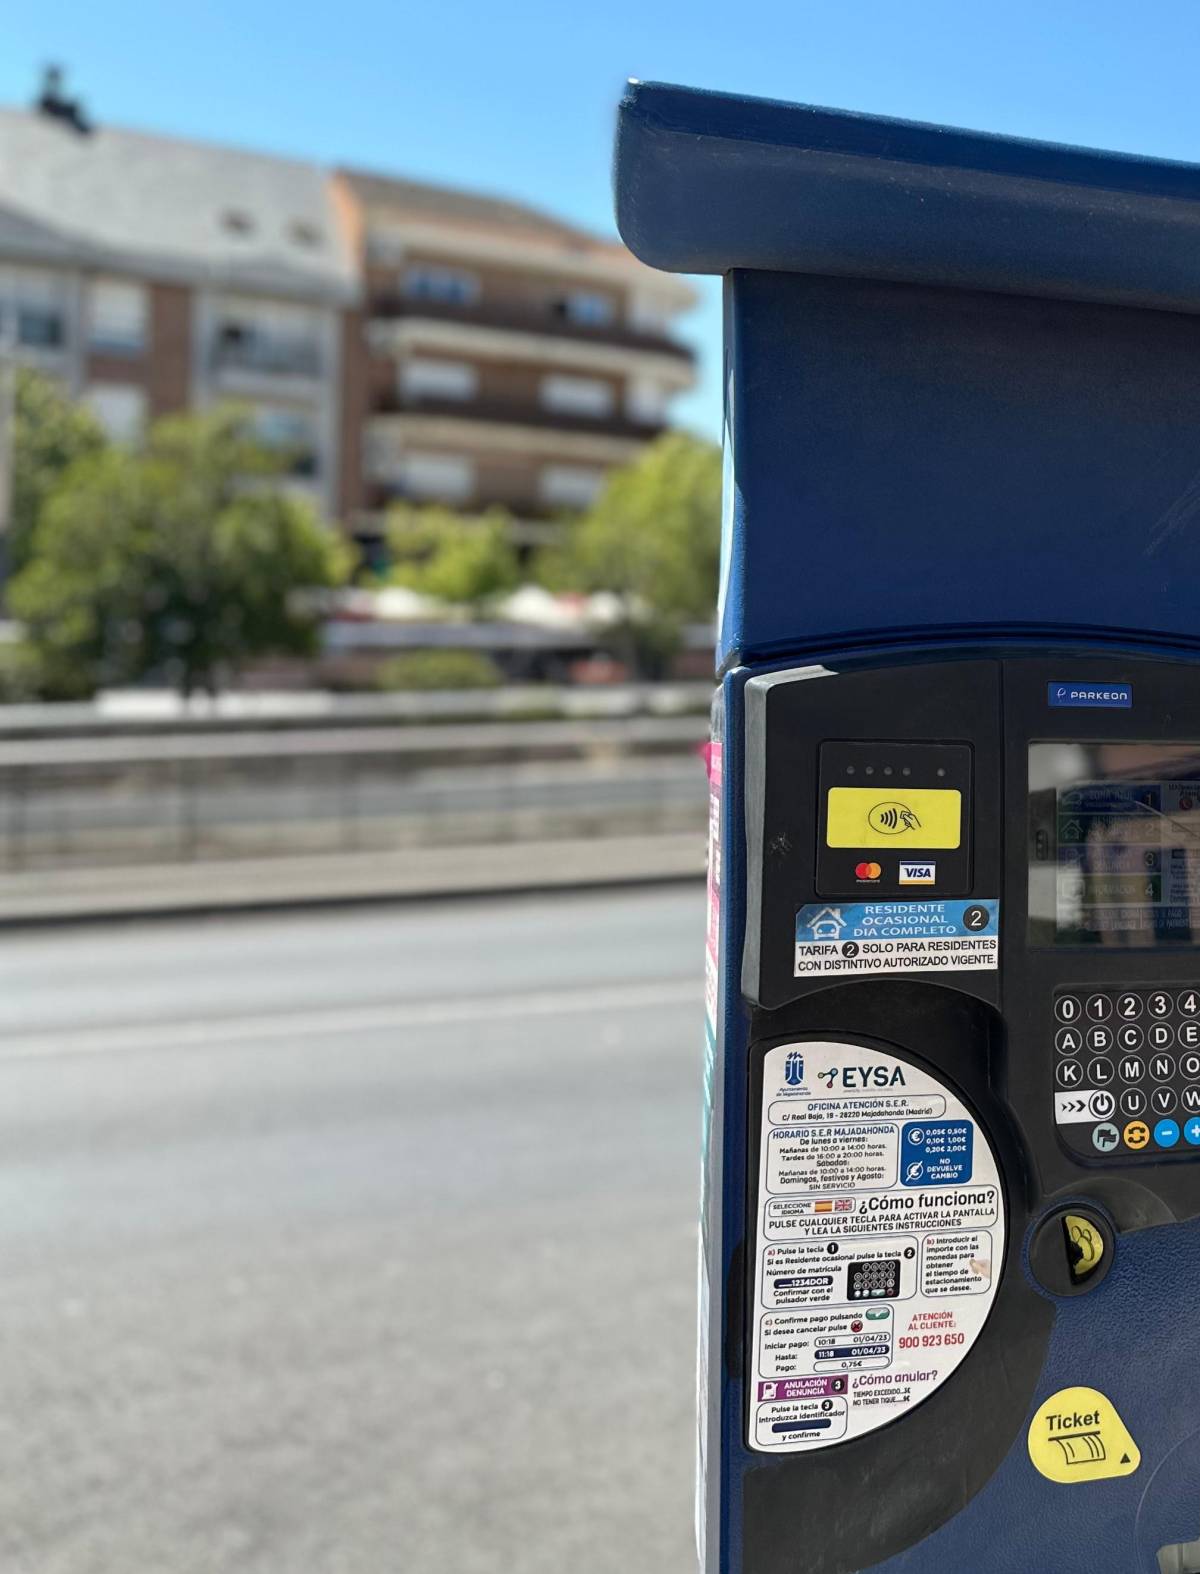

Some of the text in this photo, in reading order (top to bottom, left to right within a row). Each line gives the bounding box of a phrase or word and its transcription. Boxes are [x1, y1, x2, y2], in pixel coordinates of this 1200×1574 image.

[1071, 691, 1128, 700] PARKEON
[904, 868, 931, 878] VISA
[865, 904, 945, 914] RESIDENTE
[862, 911, 982, 926] OCASIONAL 2
[854, 926, 956, 936] DIA COMPLETO
[800, 945, 837, 956] TARIFA
[862, 943, 893, 953] SOLO
[897, 942, 926, 951] PARA
[928, 940, 996, 950] RESIDENTES
[798, 955, 996, 971] CON DISTINTIVO AUTORIZADO VIGENTE.
[1063, 1000, 1074, 1018] 0
[1124, 997, 1135, 1016] 2
[1155, 996, 1166, 1014] 3
[1184, 994, 1196, 1012] 4
[1062, 1033, 1076, 1049] A
[1094, 1031, 1106, 1047] B
[1125, 1030, 1137, 1045] C
[1156, 1028, 1167, 1043] D
[1186, 1026, 1198, 1042] E
[1064, 1065, 1077, 1081] K
[1097, 1064, 1107, 1079] L
[1125, 1062, 1139, 1078] M
[1157, 1059, 1168, 1075] N
[1186, 1057, 1200, 1073] O
[842, 1065, 906, 1088] EYSA
[807, 1103, 841, 1111] OFICINA
[842, 1100, 884, 1110] ATENCIÓN
[1128, 1095, 1139, 1110] U
[1158, 1093, 1170, 1108] V
[861, 1109, 905, 1118] Majadahonda
[906, 1108, 932, 1116] (Madrid)
[773, 1130, 809, 1139] HORARIO
[834, 1126, 894, 1136] MAJADAHONDA
[779, 1169, 807, 1177] Mañanas
[780, 1173, 884, 1184] Domingos, festivos Agosto:
[822, 1182, 855, 1190] SERVICIO
[859, 1191, 995, 1215] ¿Cómo funciona?
[769, 1208, 995, 1229] PULSE CUALQUIER TECLA PARA ACTIVAR LA PANTALLA
[812, 1219, 962, 1235] LEA LA SIGUIENTES INSTRUCCIONES
[807, 1245, 824, 1253] tecla
[926, 1253, 957, 1261] monedas
[925, 1276, 982, 1285] estacionamiento
[773, 1289, 810, 1297] Confirmar
[776, 1296, 807, 1305] pulsador
[830, 1313, 862, 1321] pulsando
[912, 1310, 953, 1322] ATENCIÓN
[796, 1326, 826, 1334] cancelar
[828, 1324, 847, 1332] pulse
[908, 1323, 918, 1331] AL
[788, 1341, 809, 1349] pago:
[853, 1334, 887, 1344] 01/04/23
[899, 1333, 964, 1348] 900 923 650
[851, 1347, 886, 1356] 01/04/23
[784, 1379, 828, 1389] ANULACIÓN
[852, 1370, 938, 1389] ¿Cómo anular?
[787, 1388, 825, 1397] DENUNCIA
[1046, 1410, 1100, 1431] Ticket
[788, 1431, 821, 1440] confirme
